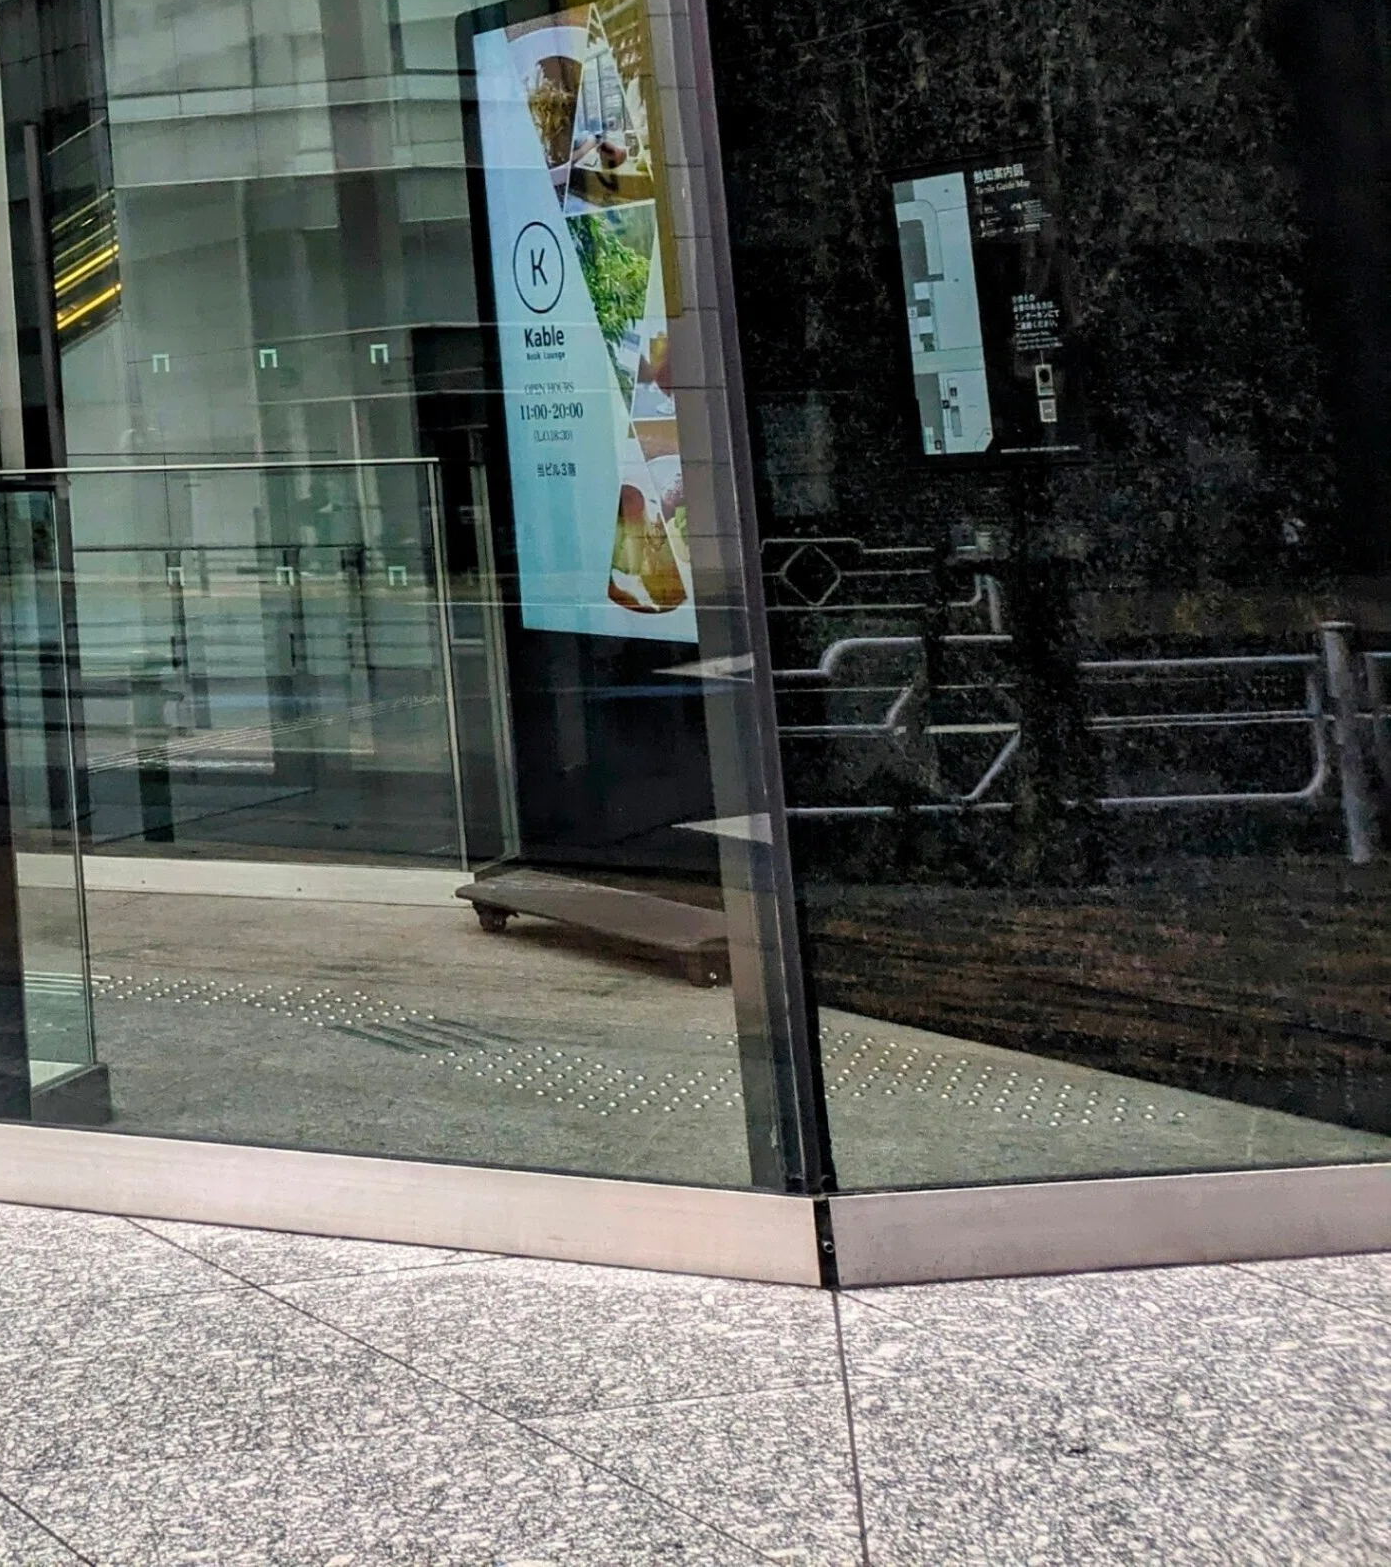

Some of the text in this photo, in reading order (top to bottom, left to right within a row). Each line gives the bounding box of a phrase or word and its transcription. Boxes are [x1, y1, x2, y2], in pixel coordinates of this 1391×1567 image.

[530, 247, 549, 287] K
[524, 325, 565, 348] Kable
[521, 402, 583, 421] 11:00-20:00
[537, 462, 577, 477] 当ビル3階
